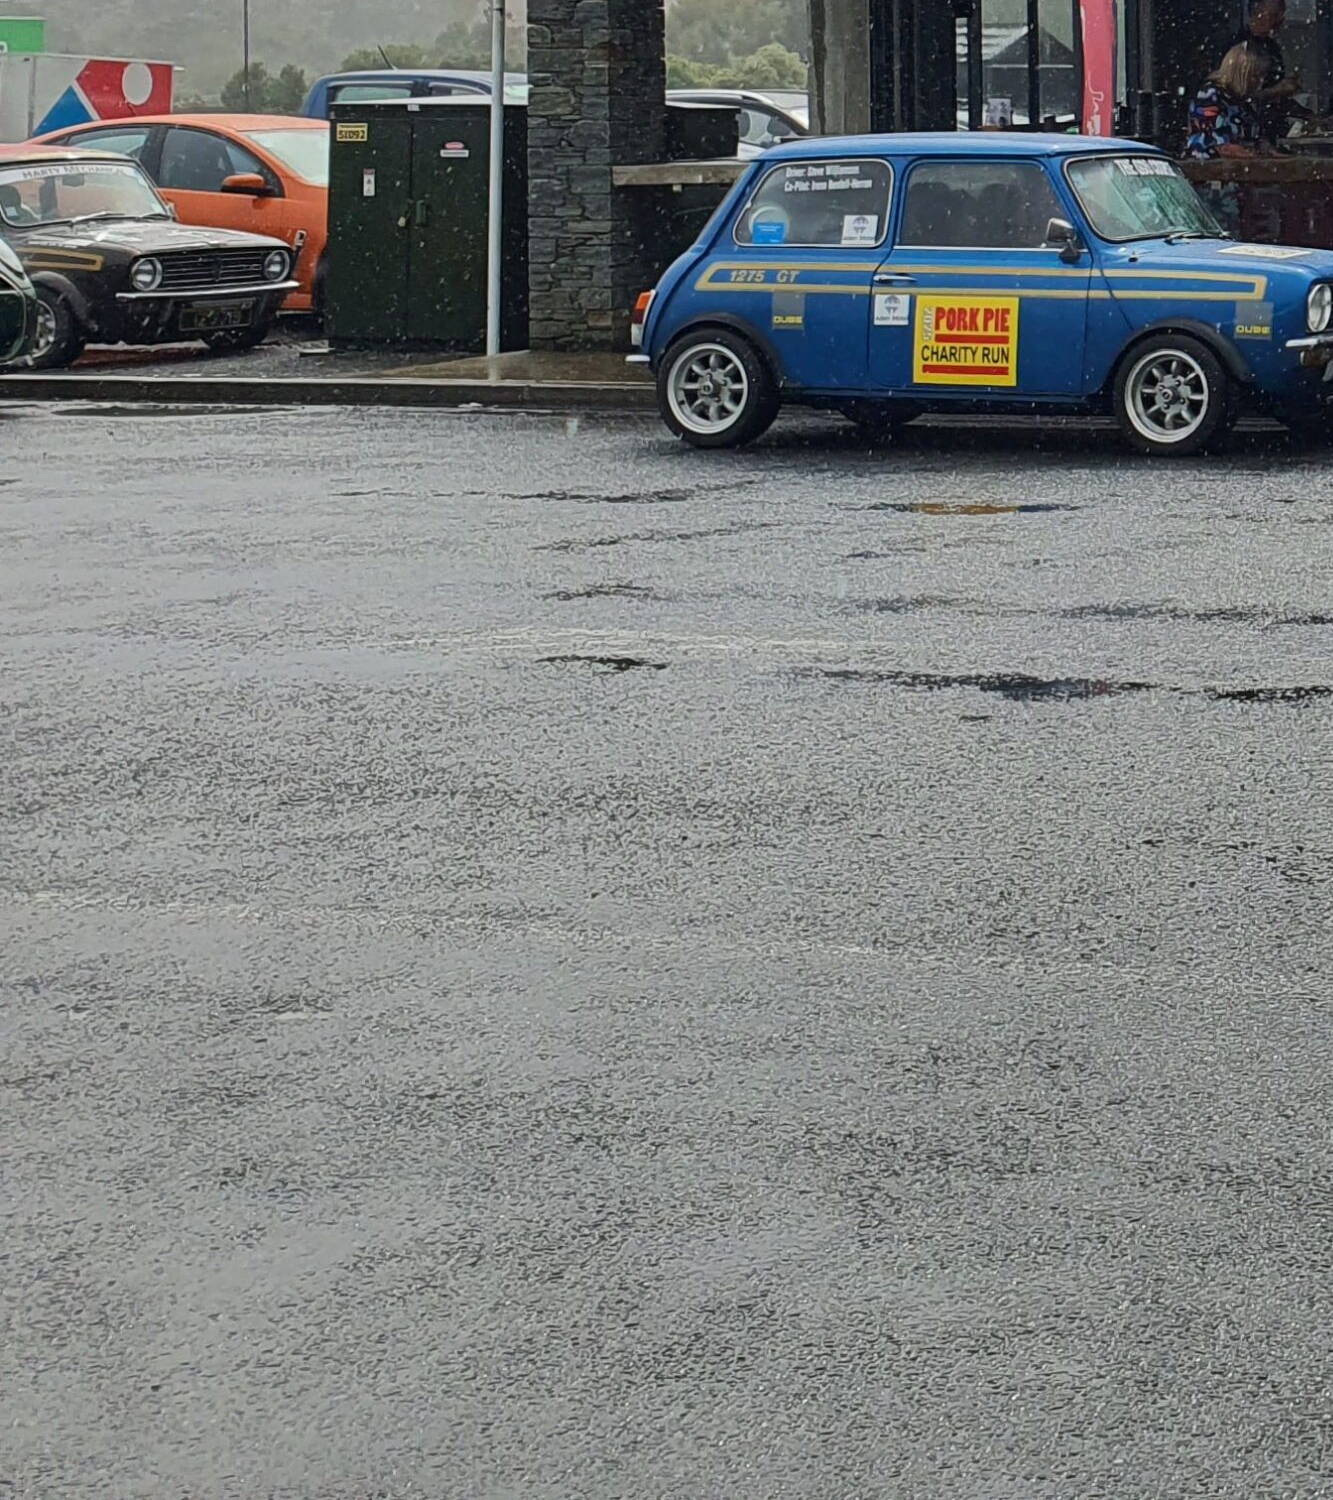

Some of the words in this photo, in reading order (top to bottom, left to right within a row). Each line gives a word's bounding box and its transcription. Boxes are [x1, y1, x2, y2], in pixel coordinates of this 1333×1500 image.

[730, 269, 766, 282] 1275
[776, 269, 800, 283] GT
[934, 306, 980, 332] PORK
[983, 307, 1011, 332] PIE
[921, 344, 979, 364] CHARITY
[982, 346, 1009, 364] RUN
